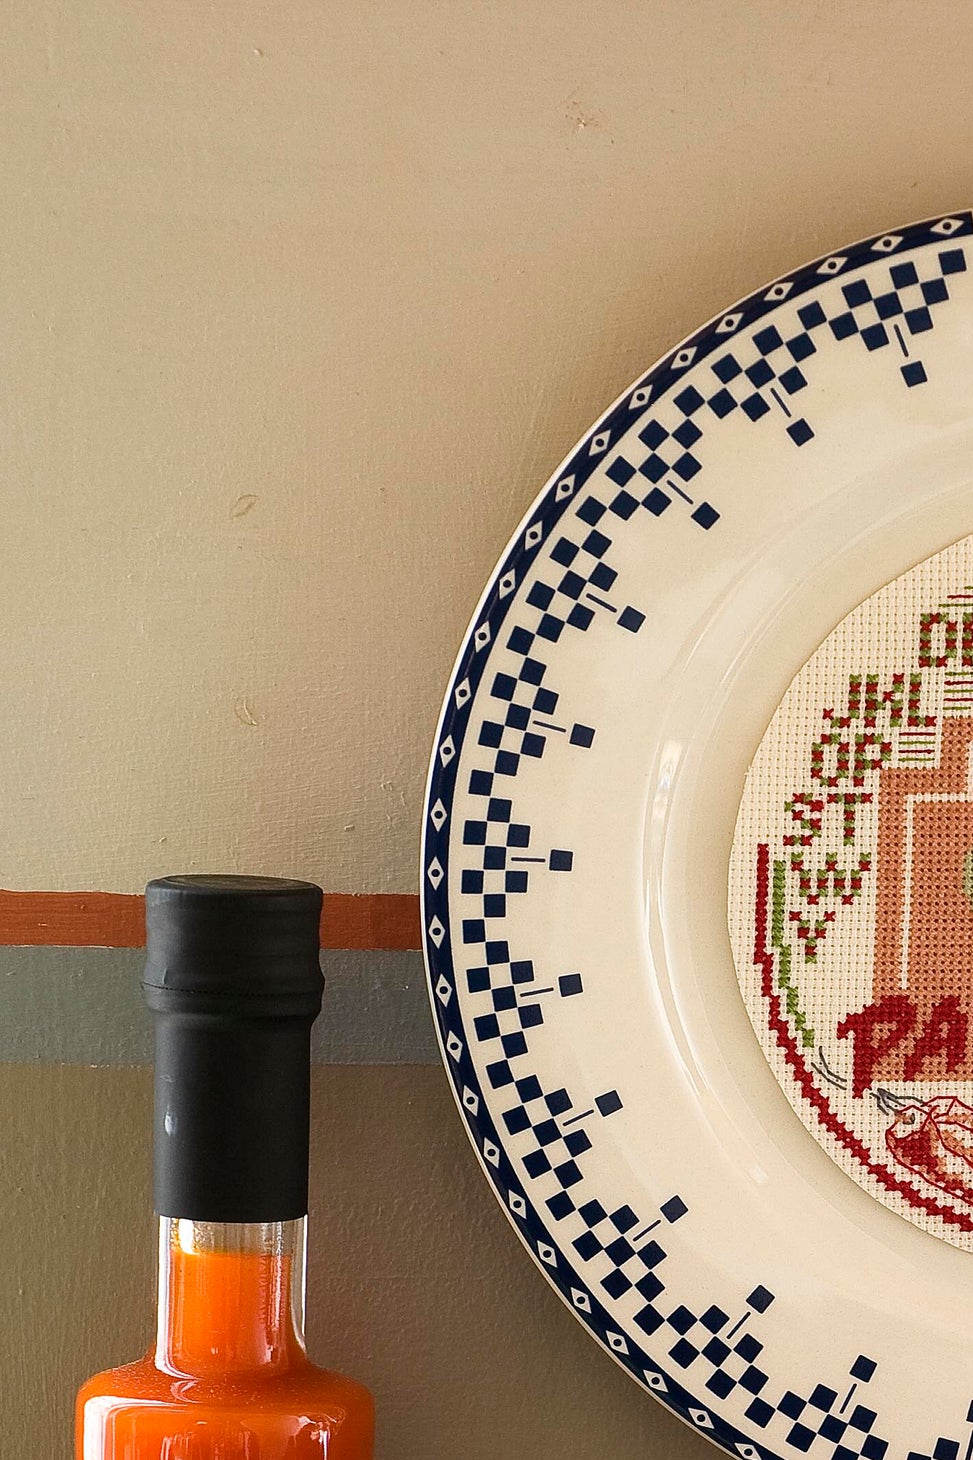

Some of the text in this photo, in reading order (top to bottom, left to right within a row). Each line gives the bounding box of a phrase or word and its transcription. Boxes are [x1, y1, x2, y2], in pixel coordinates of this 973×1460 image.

[822, 672, 937, 728] JKL
[811, 733, 892, 787] OP
[783, 793, 873, 847] ST
[789, 911, 836, 965] Y
